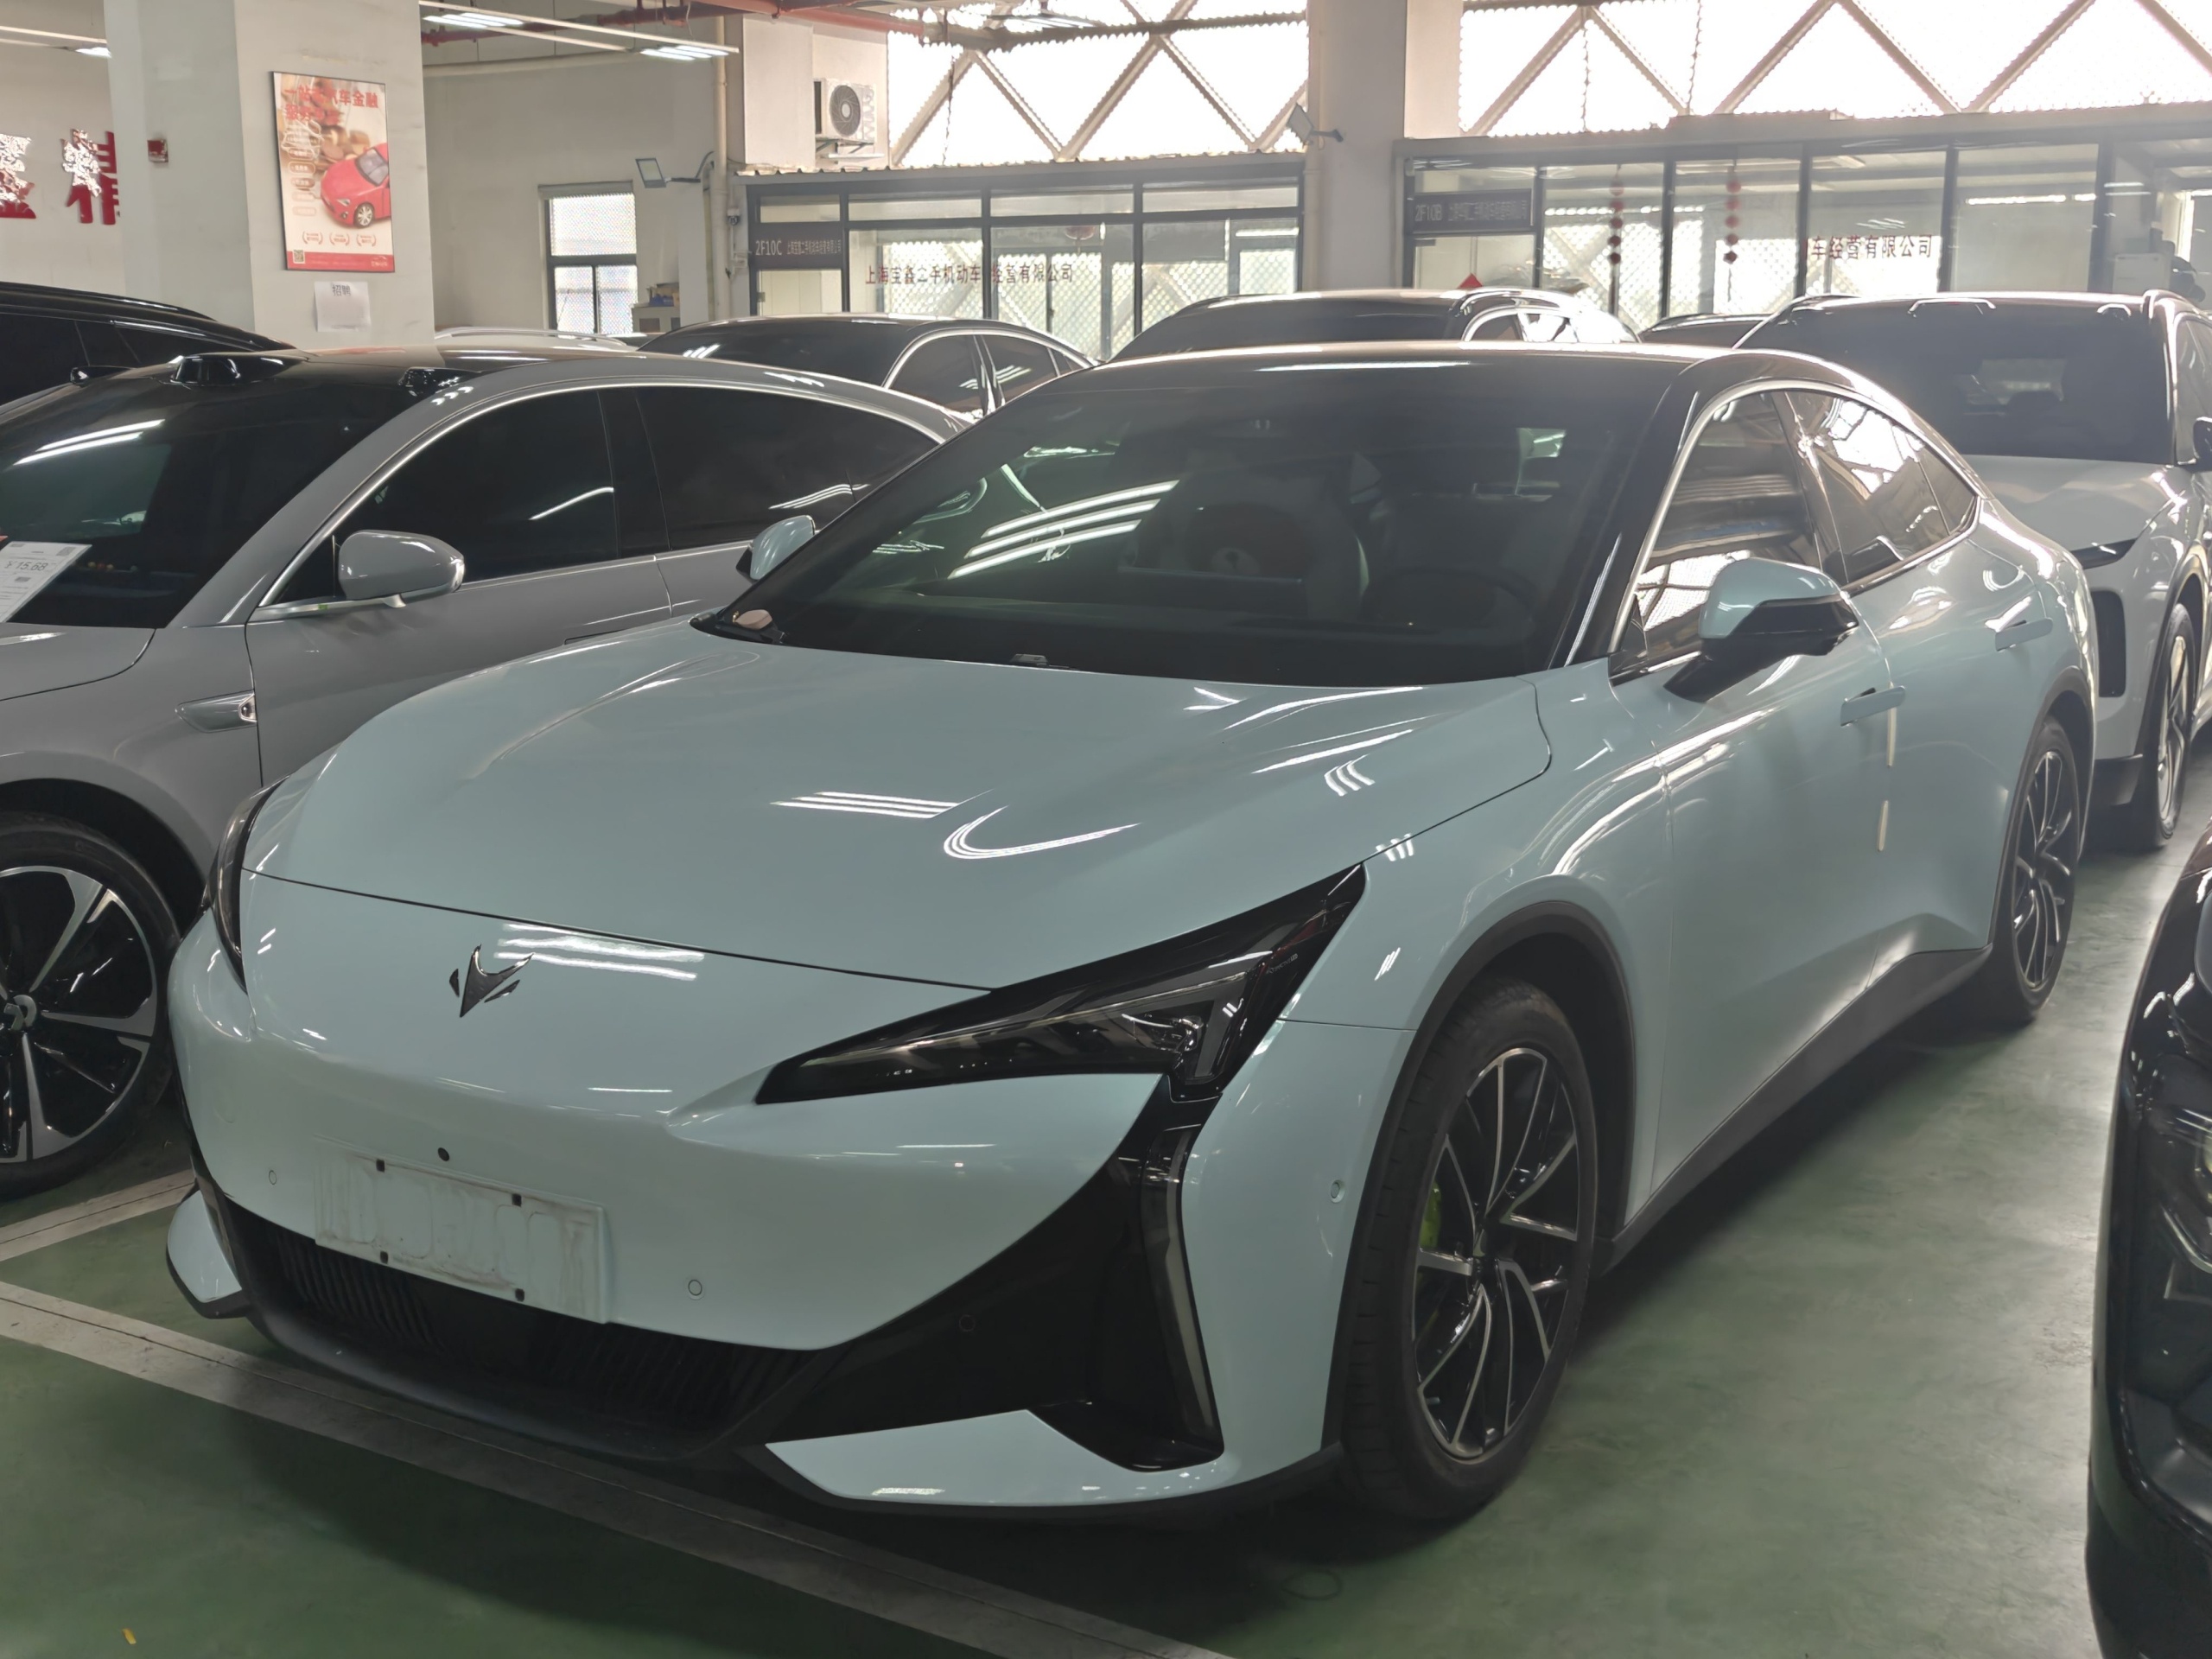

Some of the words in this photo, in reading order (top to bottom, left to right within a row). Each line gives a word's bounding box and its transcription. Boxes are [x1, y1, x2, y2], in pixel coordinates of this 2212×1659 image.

[755, 239, 783, 255] 2F10C
[1802, 235, 1932, 259] 车经营有限公司
